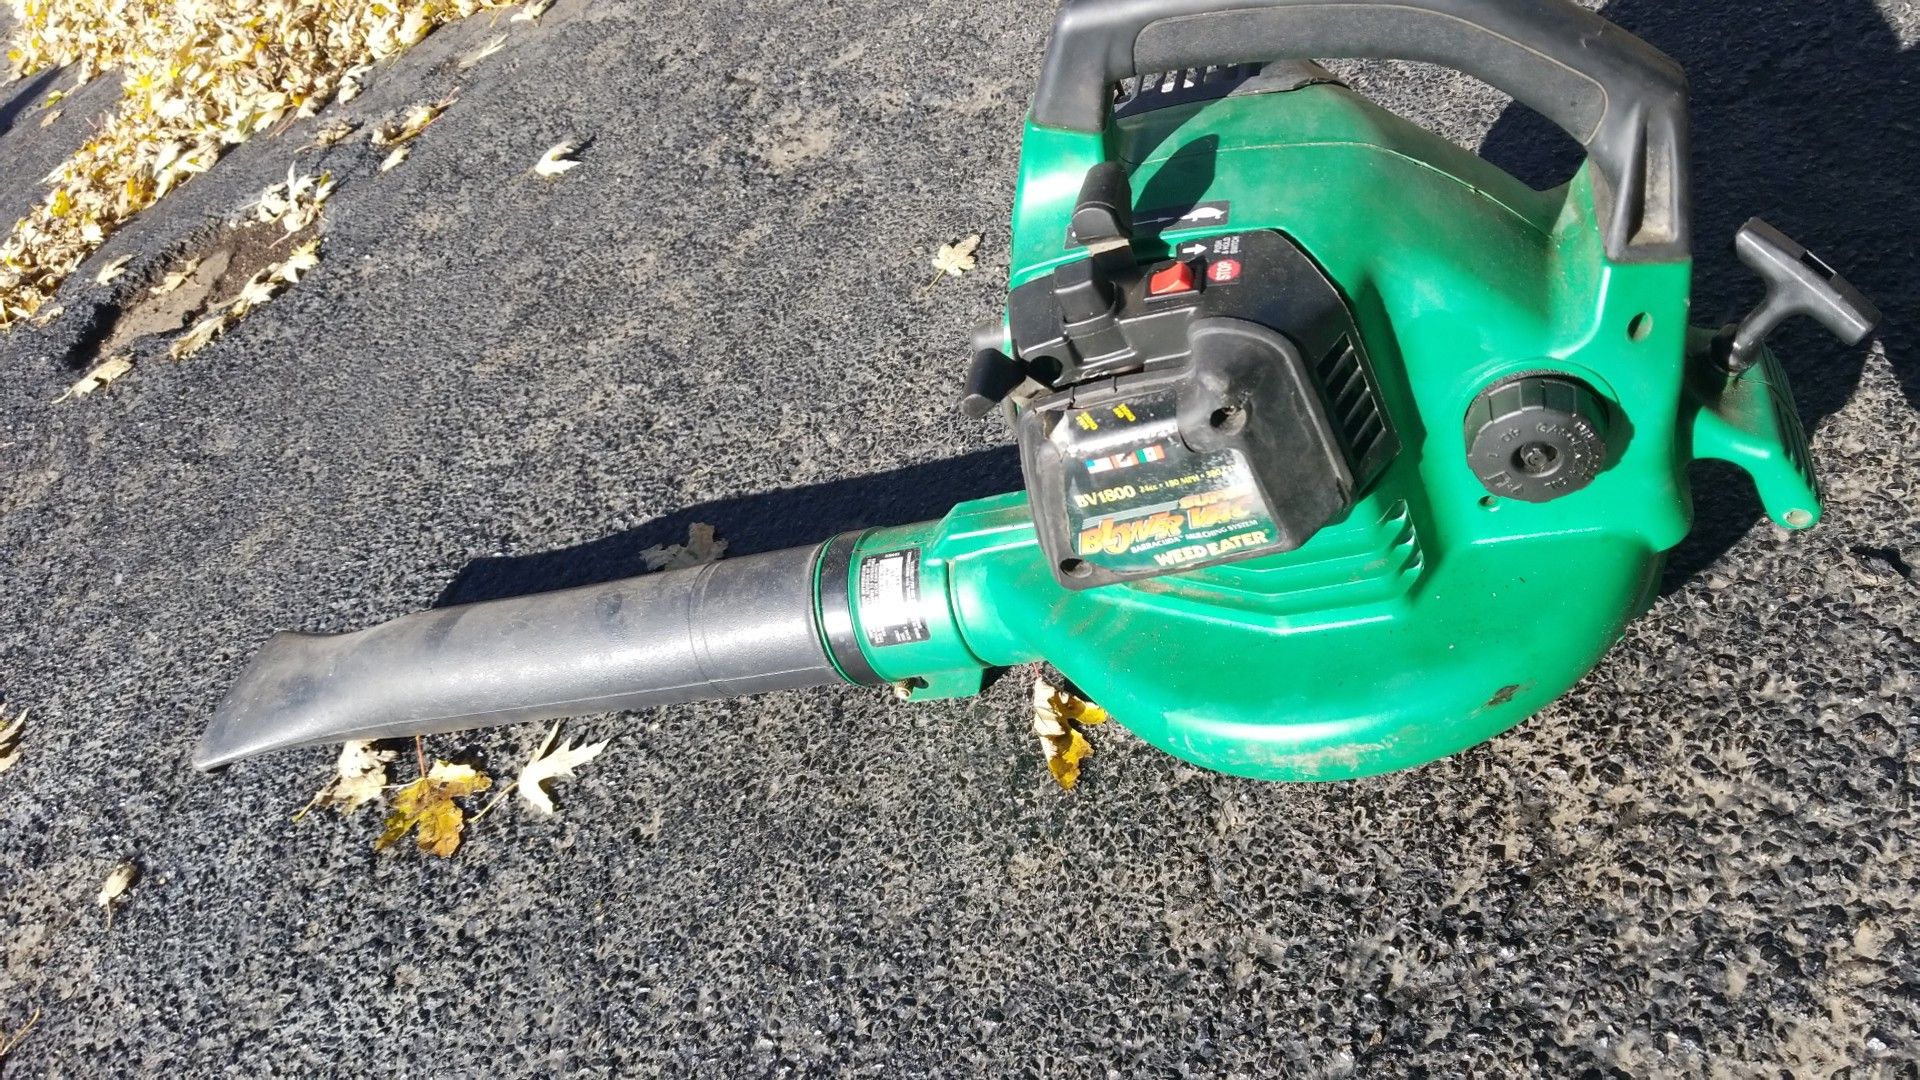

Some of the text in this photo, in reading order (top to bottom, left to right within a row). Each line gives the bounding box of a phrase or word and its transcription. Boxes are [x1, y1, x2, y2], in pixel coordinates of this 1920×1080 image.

[1215, 261, 1232, 281] STOP
[1074, 485, 1136, 508] BV1800
[1226, 519, 1258, 532] SYSTEM
[1153, 530, 1268, 567] WEED EATER
